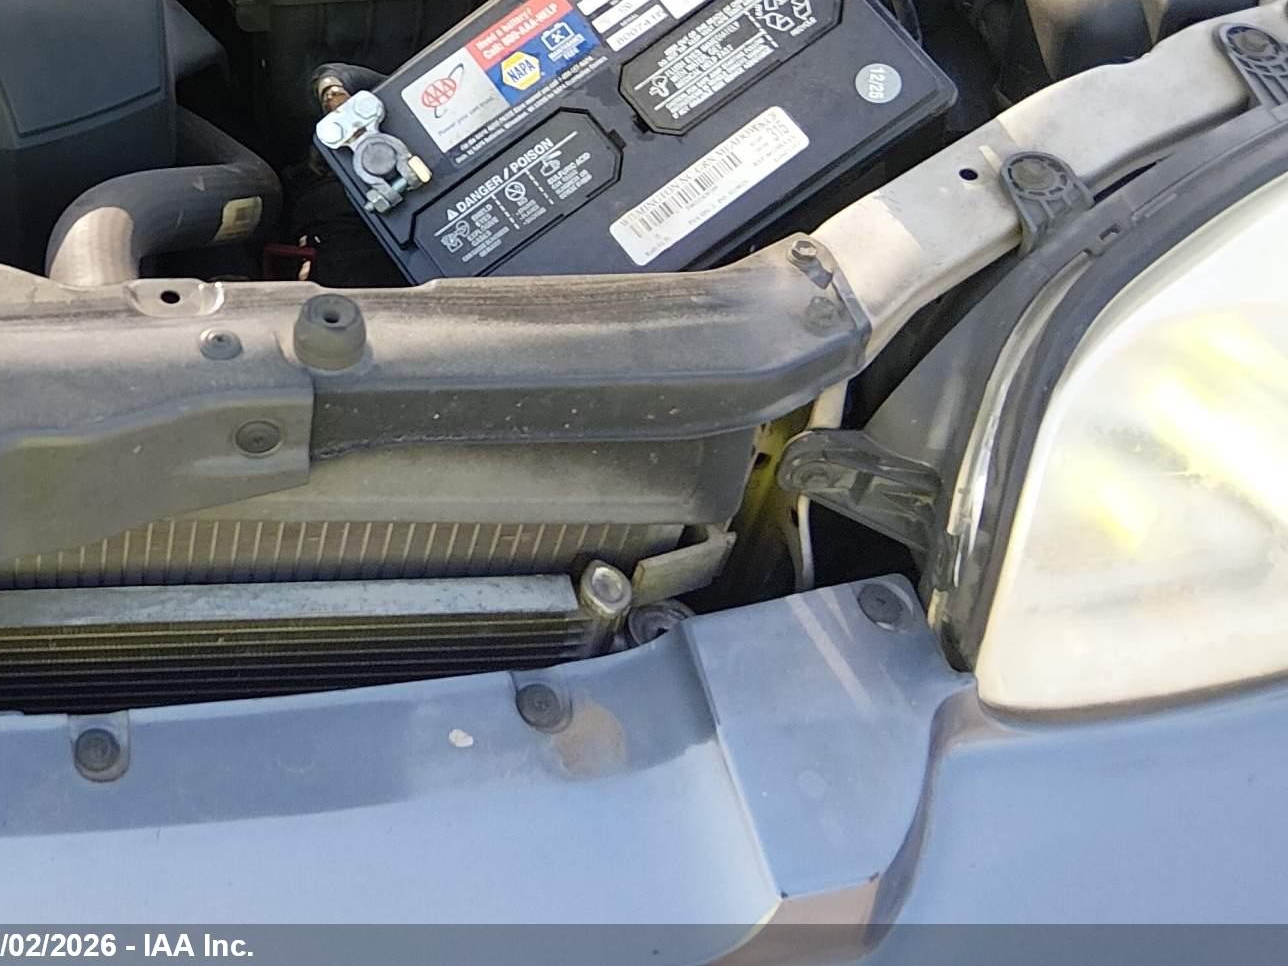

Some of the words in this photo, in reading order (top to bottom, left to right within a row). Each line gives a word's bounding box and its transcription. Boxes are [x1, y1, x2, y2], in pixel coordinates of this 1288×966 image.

[507, 59, 536, 83] NAPA
[422, 77, 456, 109] AAA
[765, 120, 790, 142] 315
[576, 152, 590, 165] ACID
[456, 175, 503, 212] DANGER
[509, 138, 554, 173] POISON
